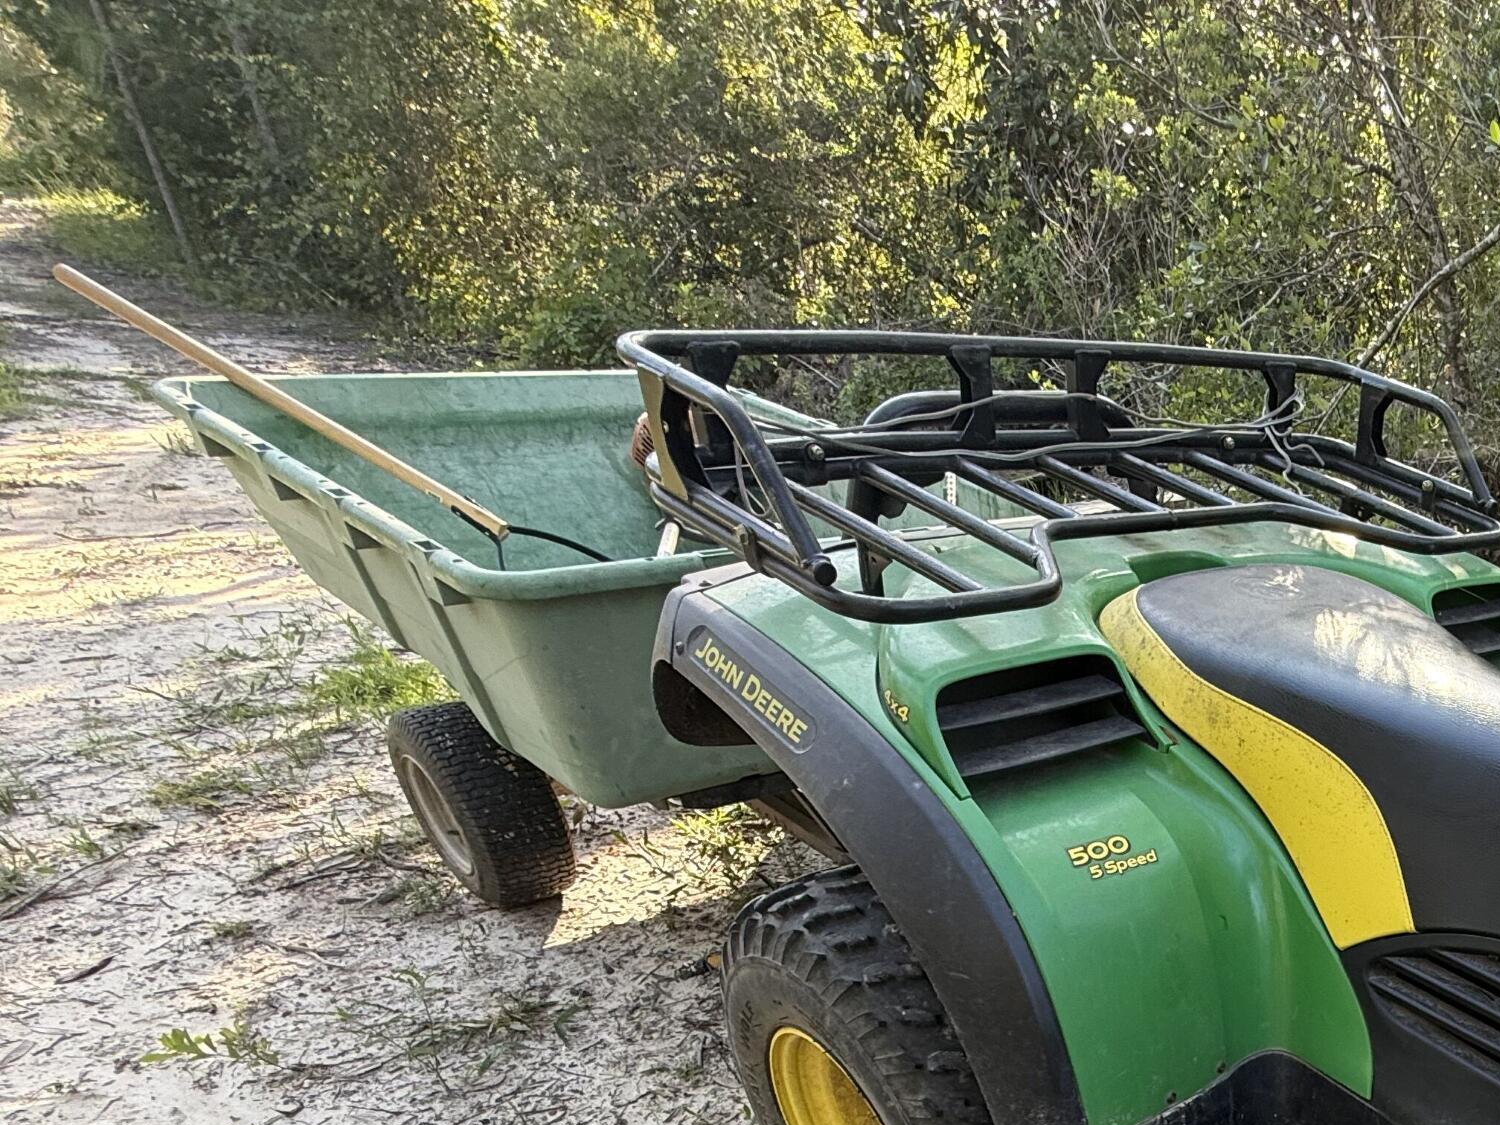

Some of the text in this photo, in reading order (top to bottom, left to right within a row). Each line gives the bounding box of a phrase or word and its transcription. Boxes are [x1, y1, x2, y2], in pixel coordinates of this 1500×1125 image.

[695, 638, 808, 744] JOHN DEERE
[1067, 835, 1130, 867] 500
[1089, 848, 1158, 879] 5 Speed
